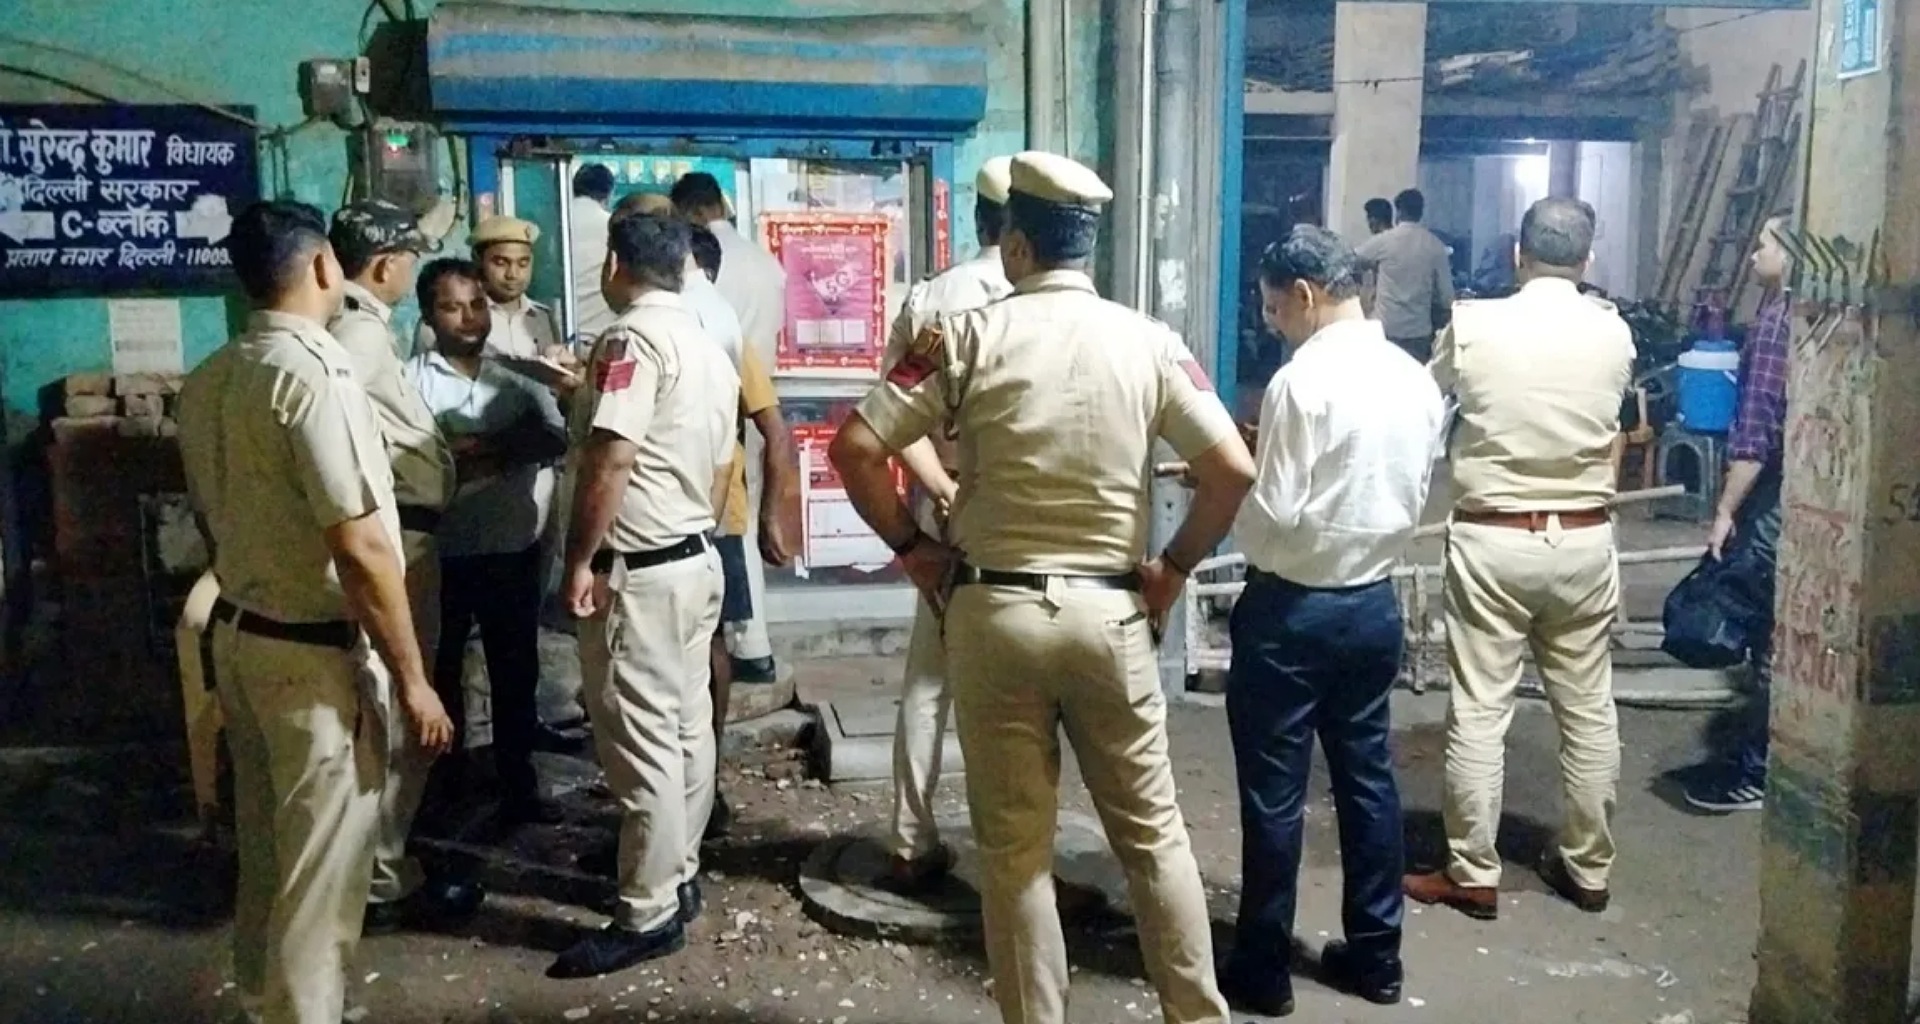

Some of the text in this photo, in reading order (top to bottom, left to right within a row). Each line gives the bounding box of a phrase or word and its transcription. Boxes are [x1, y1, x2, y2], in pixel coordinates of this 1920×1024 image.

[90, 129, 156, 175] कुमार
[165, 134, 236, 166] विधायक
[23, 173, 200, 207] दिल्ली सरकार
[5, 248, 57, 268] प्रताप
[60, 248, 114, 267] नगर
[117, 240, 176, 270] दिल्ली
[825, 270, 851, 298] 5G
